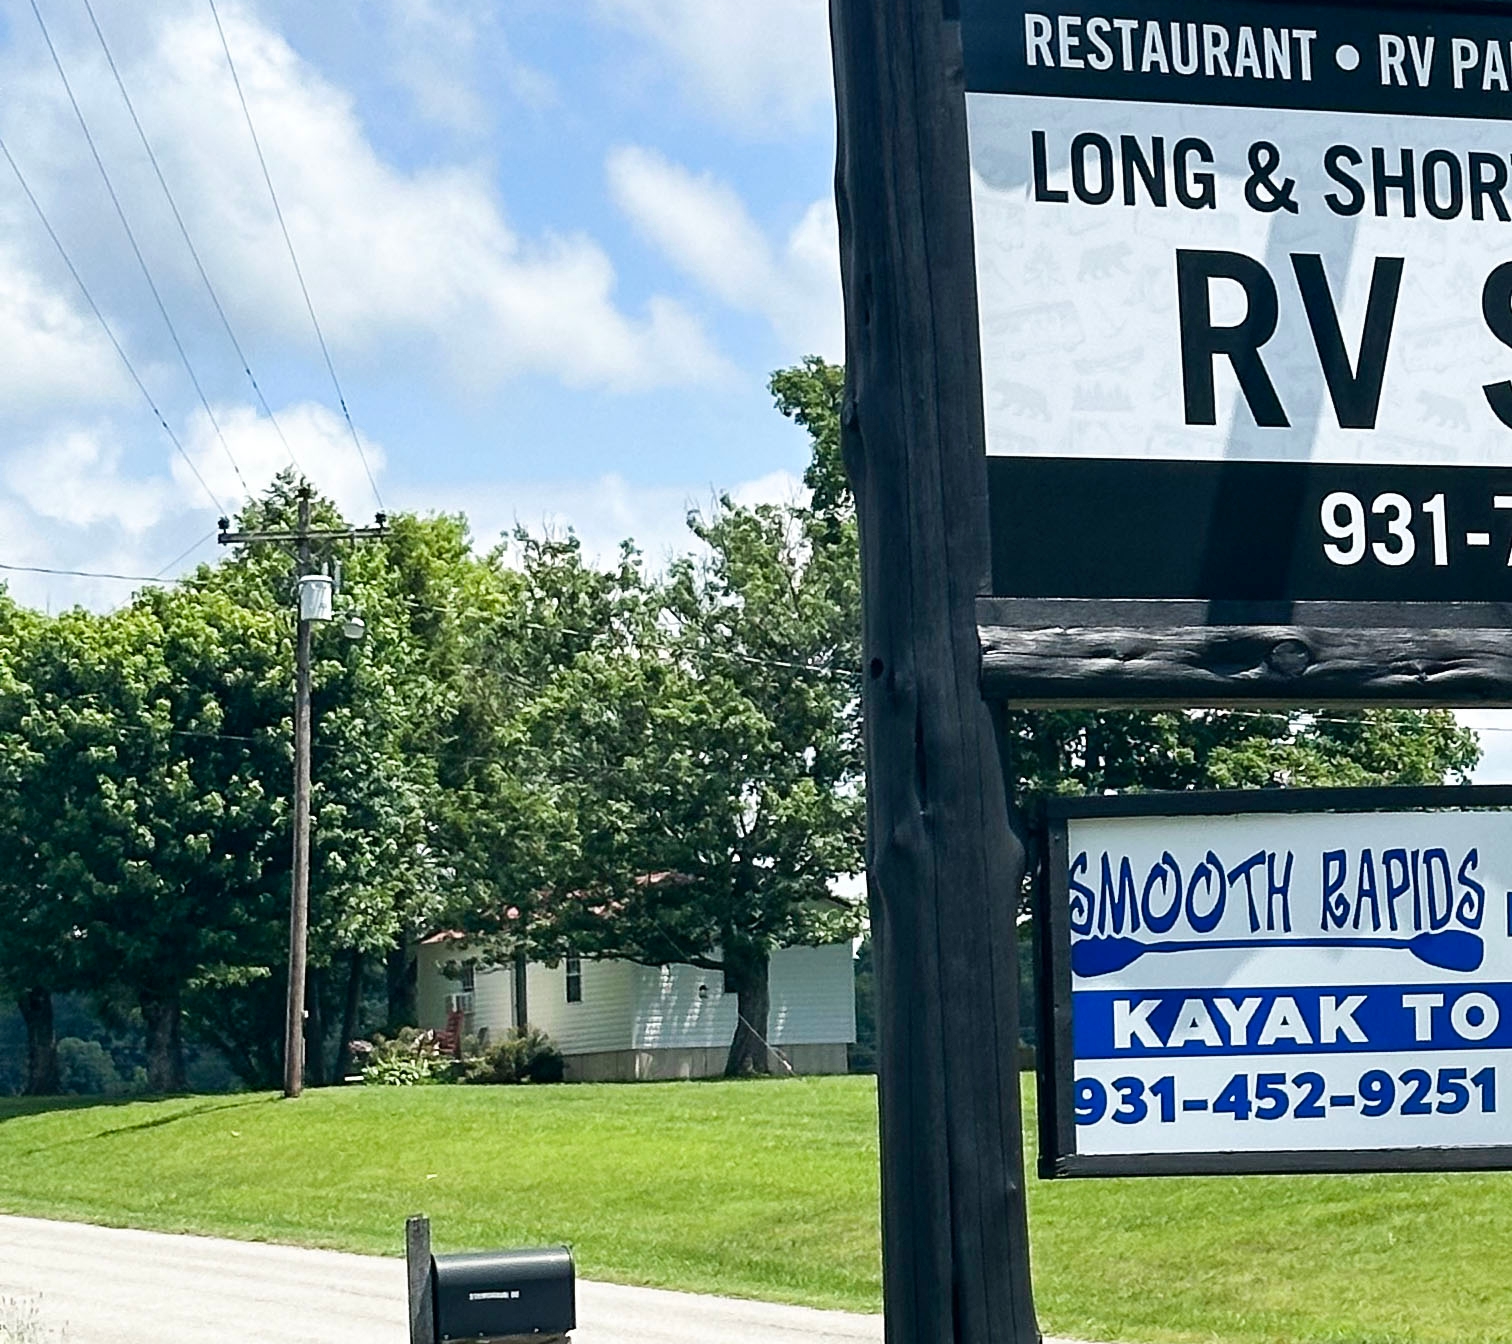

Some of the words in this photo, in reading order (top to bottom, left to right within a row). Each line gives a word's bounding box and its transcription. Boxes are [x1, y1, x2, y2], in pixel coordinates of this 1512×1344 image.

[1024, 13, 1317, 81] RESTAURANT
[1379, 34, 1435, 87] RV
[1031, 130, 1217, 210] LONG
[1244, 140, 1299, 215] &
[1175, 248, 1405, 430] RV
[1068, 849, 1295, 937] SMOOTH
[1320, 847, 1486, 932] RAPIDS
[1113, 995, 1369, 1049] KAYAK
[1402, 992, 1499, 1041] TO
[1073, 1066, 1498, 1127] 931-452-9251
